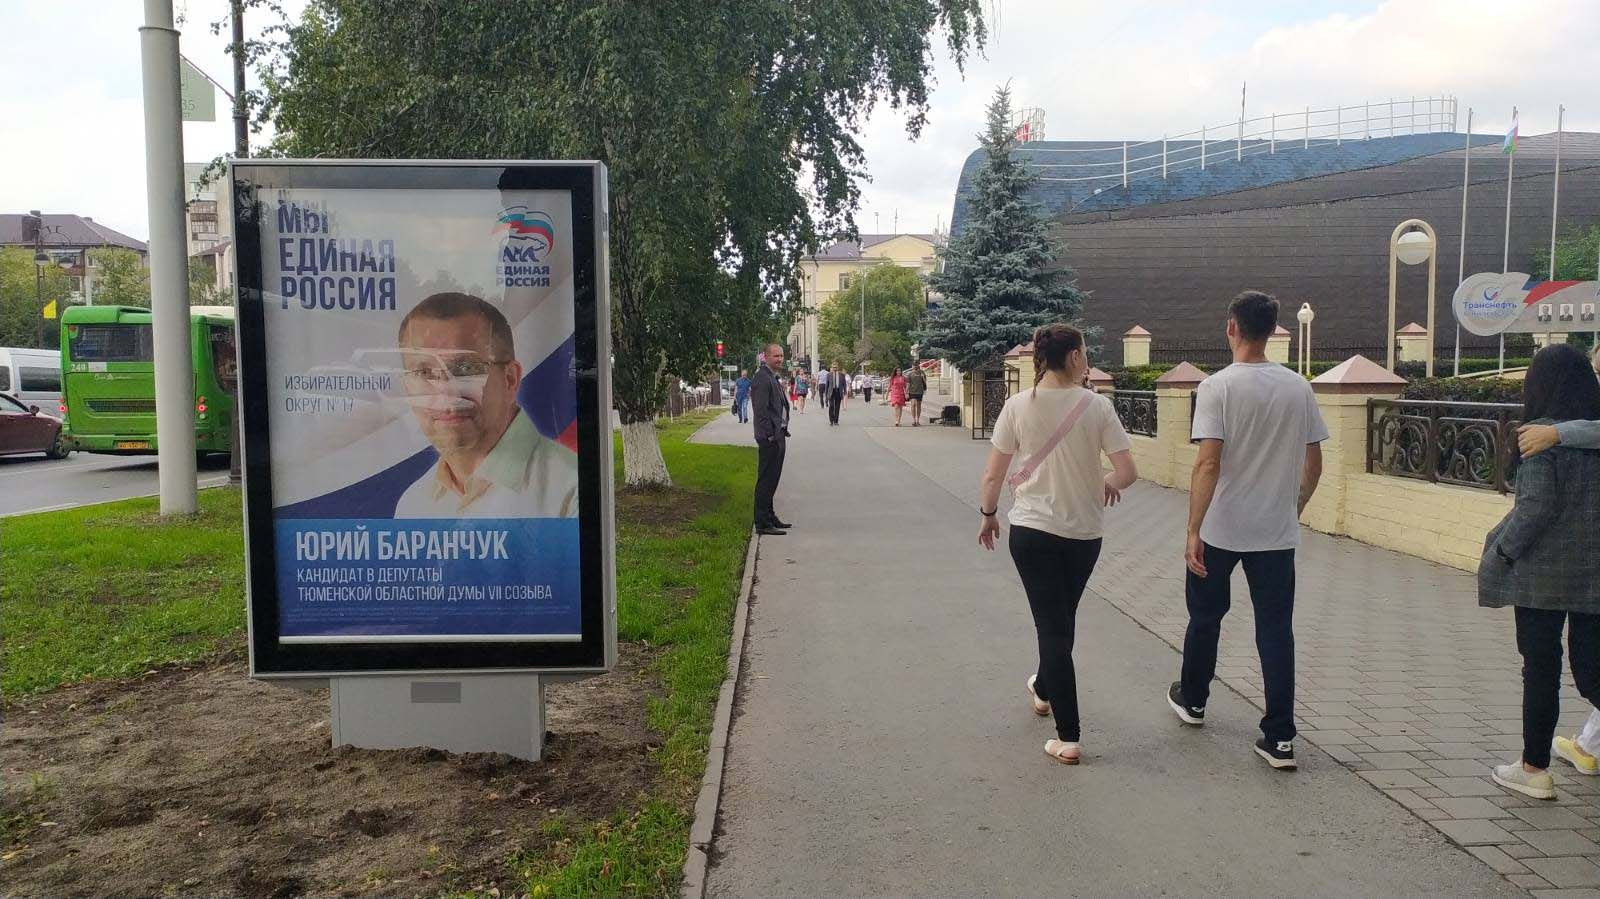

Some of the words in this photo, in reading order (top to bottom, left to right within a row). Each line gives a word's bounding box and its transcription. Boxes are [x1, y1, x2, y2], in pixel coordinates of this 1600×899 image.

[278, 201, 329, 234] МЫ
[280, 238, 395, 275] ЕДИНАЯ
[496, 265, 550, 276] ЕДИНАЯ
[496, 277, 550, 287] РОССИЯ
[281, 276, 396, 310] РОССИЯ
[285, 373, 391, 391] ИЗБИРАТЕЛЬНЫЙ
[296, 525, 370, 561] ЮРИЙ
[378, 530, 509, 560] БАРАНЧУК
[297, 567, 363, 584] КАНДИДАТ
[367, 568, 375, 581] В
[378, 567, 443, 583] ДЕПУТАТЫ
[298, 584, 372, 602] ТЮМЕНСКОЙ
[375, 584, 445, 601] ОБЛАСТНОЙ
[448, 585, 485, 602] ДУМЫ
[488, 585, 502, 600] VII
[505, 584, 553, 600] СОЗЫВА
